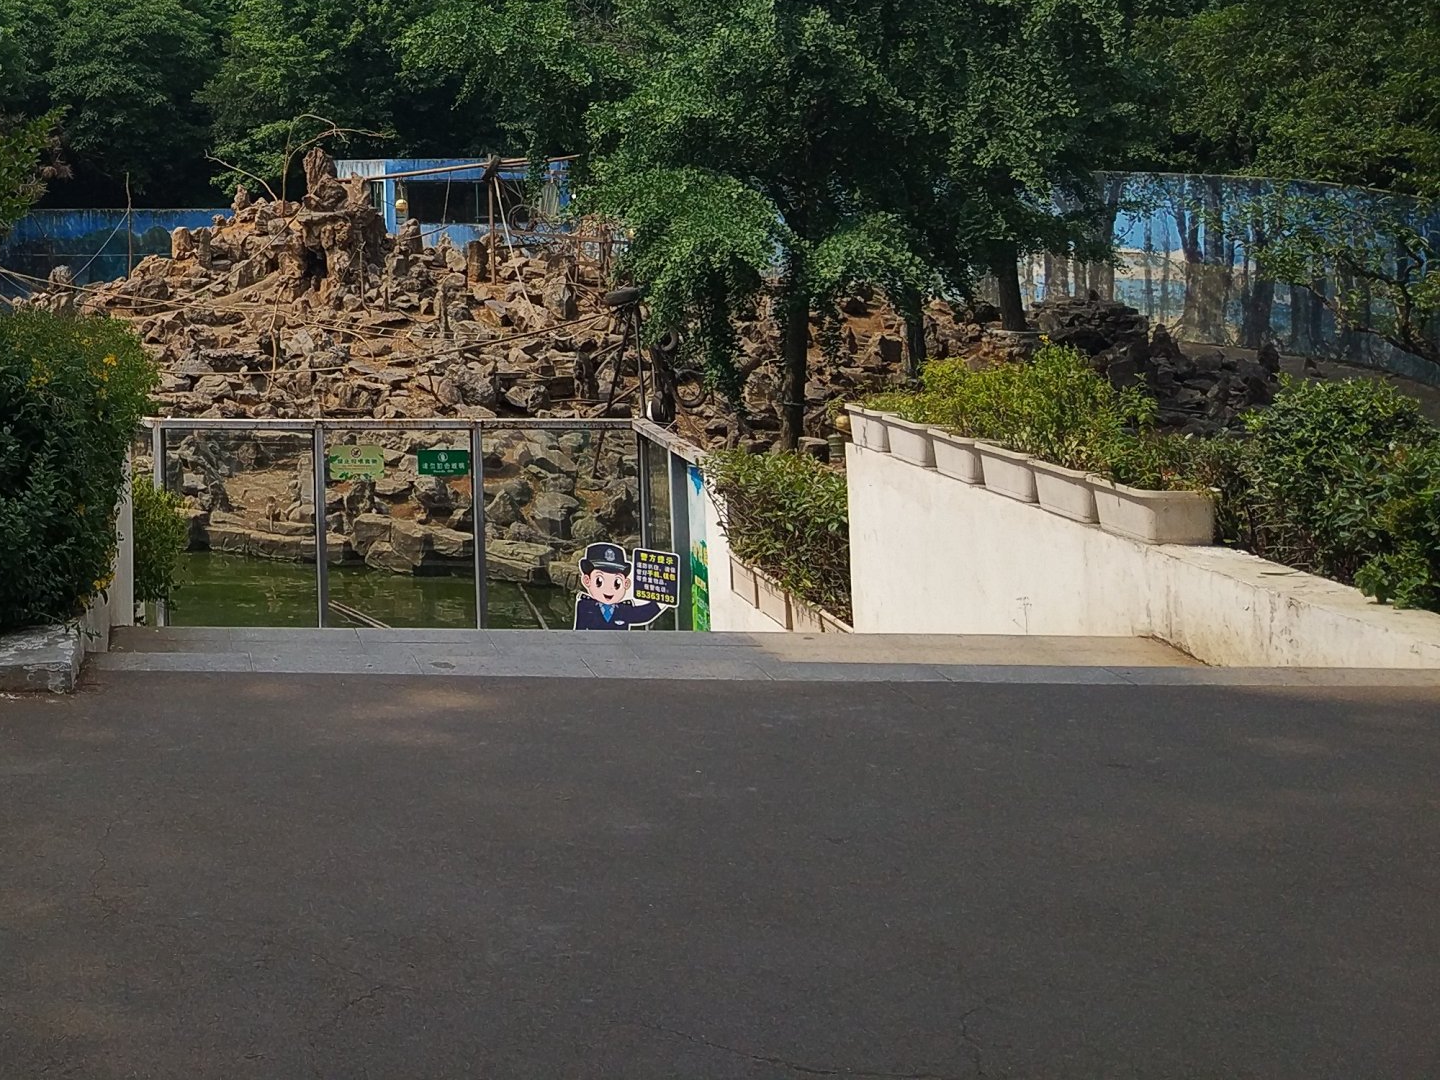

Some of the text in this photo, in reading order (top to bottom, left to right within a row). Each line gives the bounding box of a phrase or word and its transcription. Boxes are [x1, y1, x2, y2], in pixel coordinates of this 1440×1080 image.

[640, 552, 674, 565] 警方提示
[636, 590, 675, 603] 85363193
